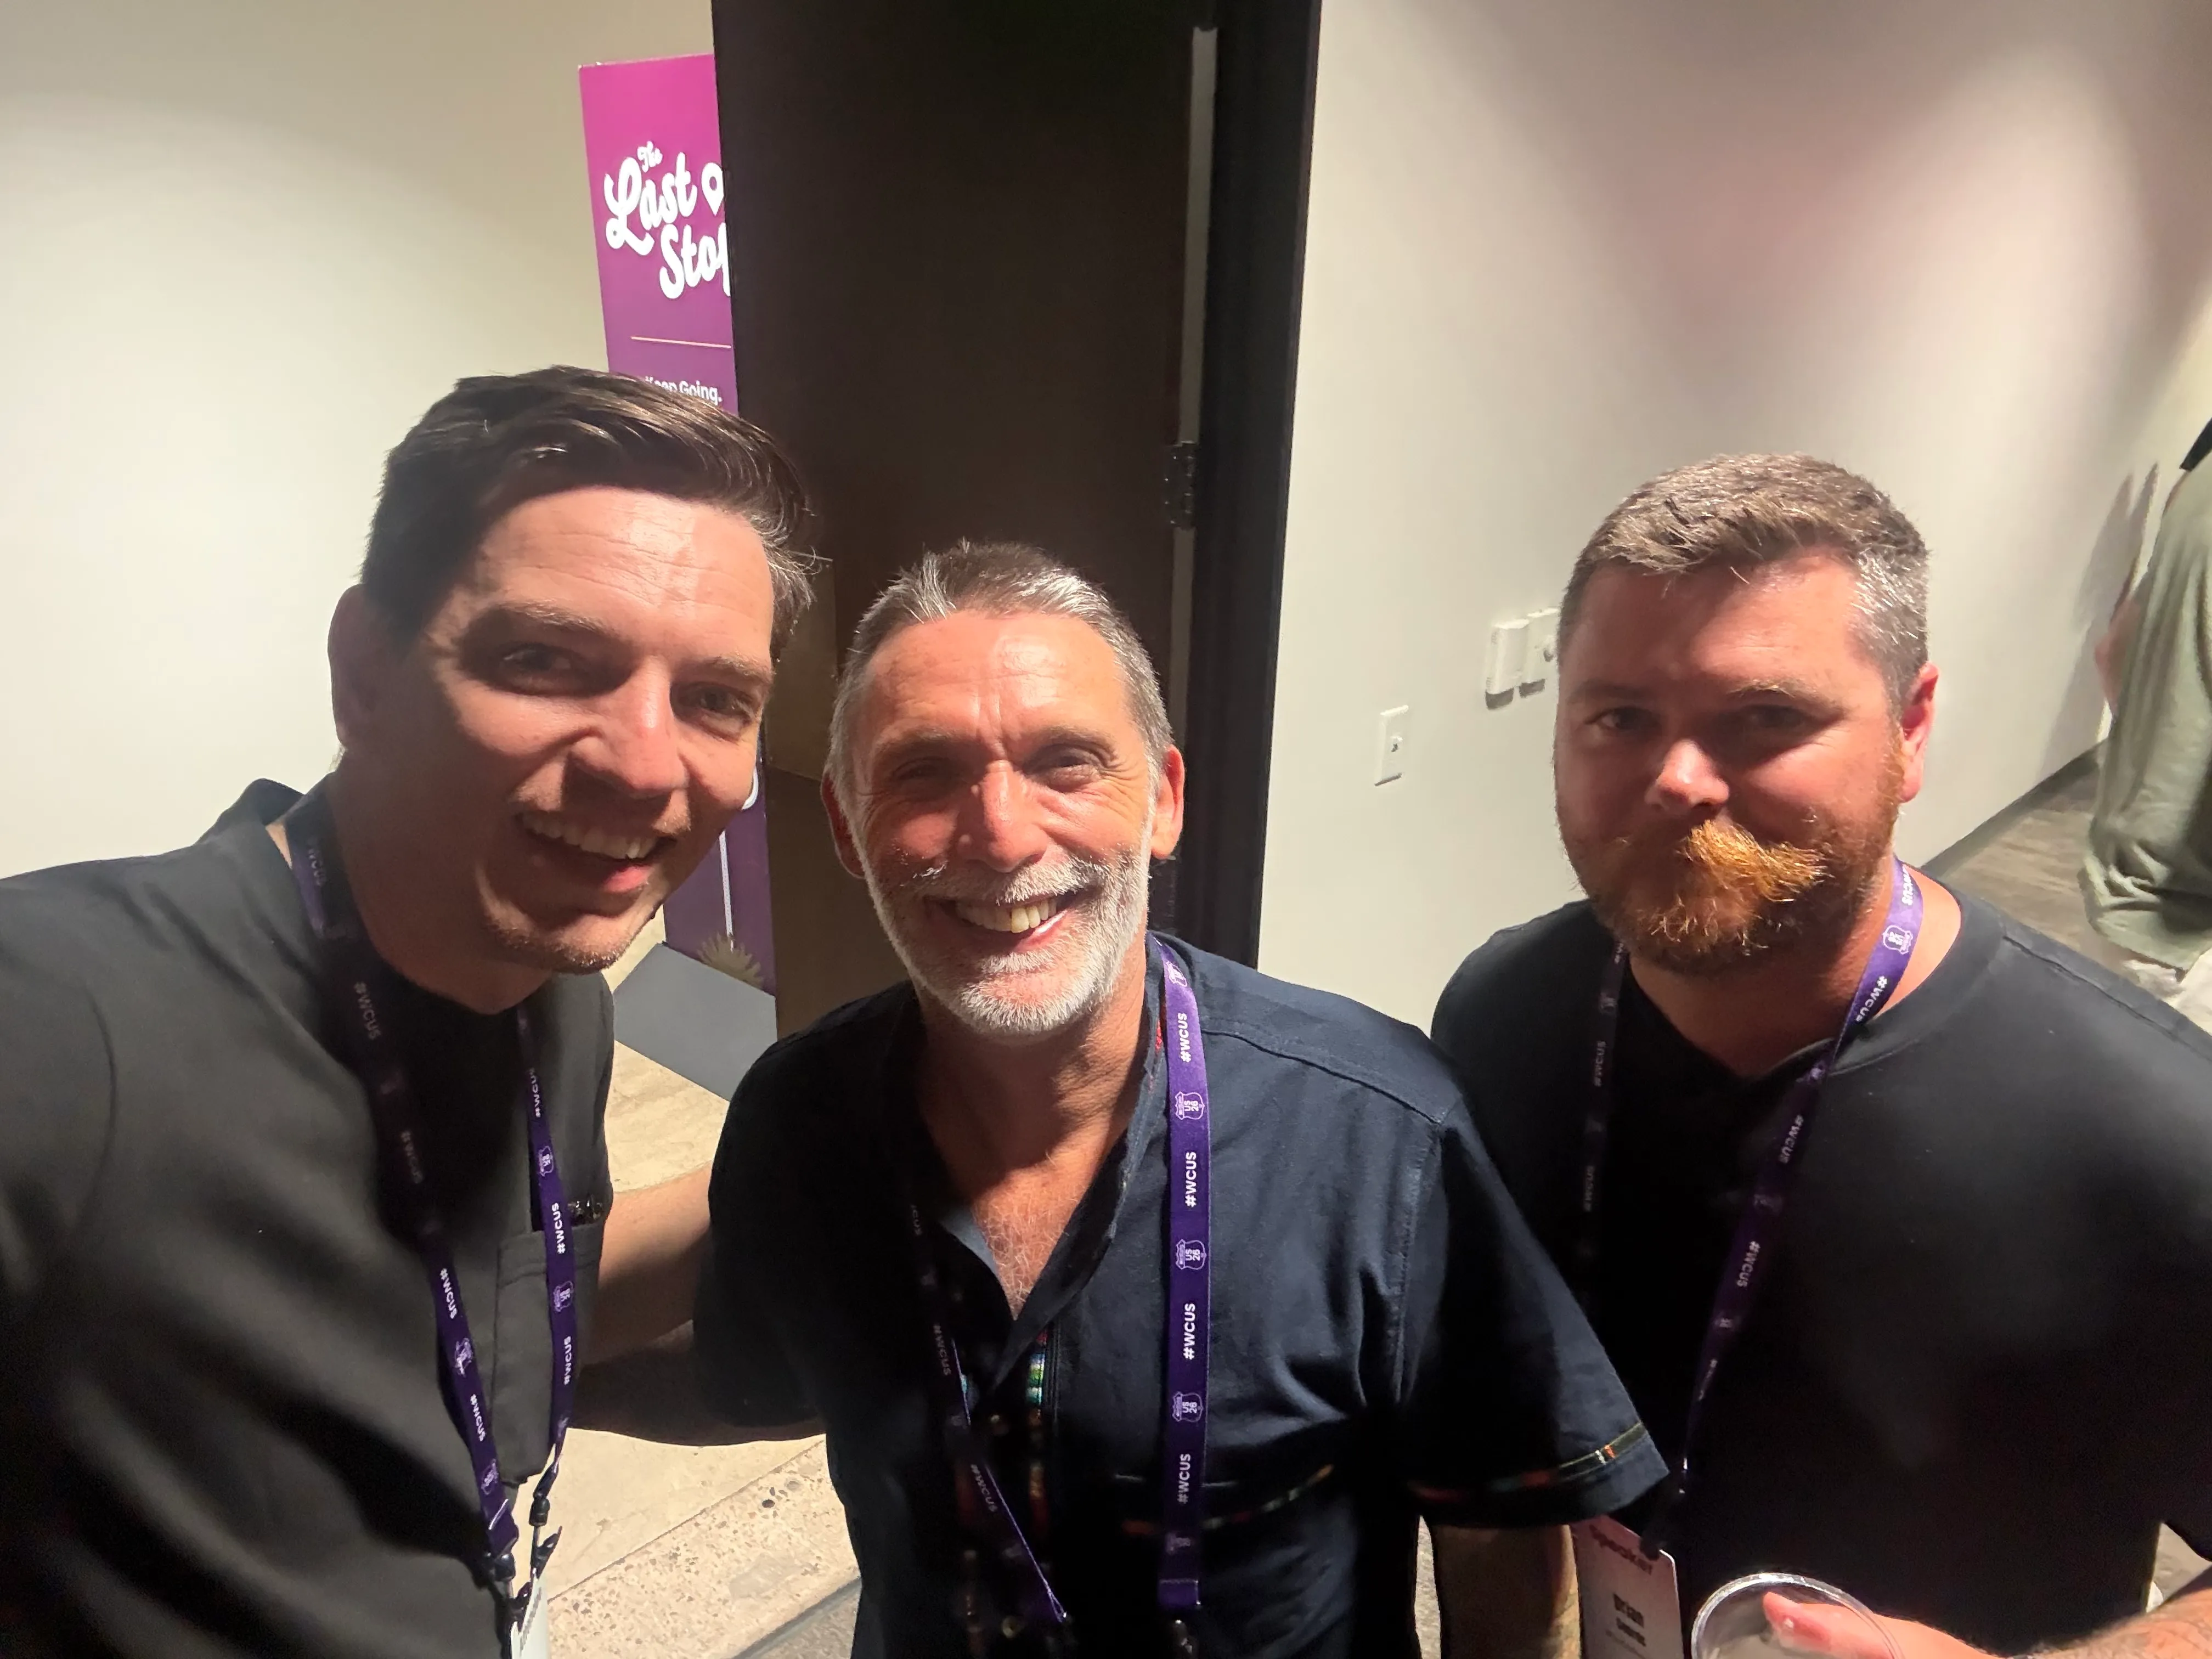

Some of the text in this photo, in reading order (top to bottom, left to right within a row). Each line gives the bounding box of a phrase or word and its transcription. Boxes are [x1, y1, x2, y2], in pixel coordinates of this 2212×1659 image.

[637, 140, 663, 173] The
[603, 152, 697, 256] Last
[679, 380, 723, 406] Going.
[353, 981, 381, 1040] #WCUS
[1177, 1012, 1192, 1063] #WCUS
[1184, 1100, 1191, 1111] US
[1190, 1100, 1199, 1112] 26
[1184, 1151, 1197, 1208] #WCUS
[551, 1202, 566, 1255] #WCUS
[1185, 1249, 1193, 1261] US
[1736, 1240, 1761, 1288] #WCUS
[439, 1268, 458, 1319] #WCUS
[1182, 1302, 1196, 1360] #WCUS
[470, 1394, 486, 1442] #WCUS
[1177, 1453, 1192, 1504] #WCUS
